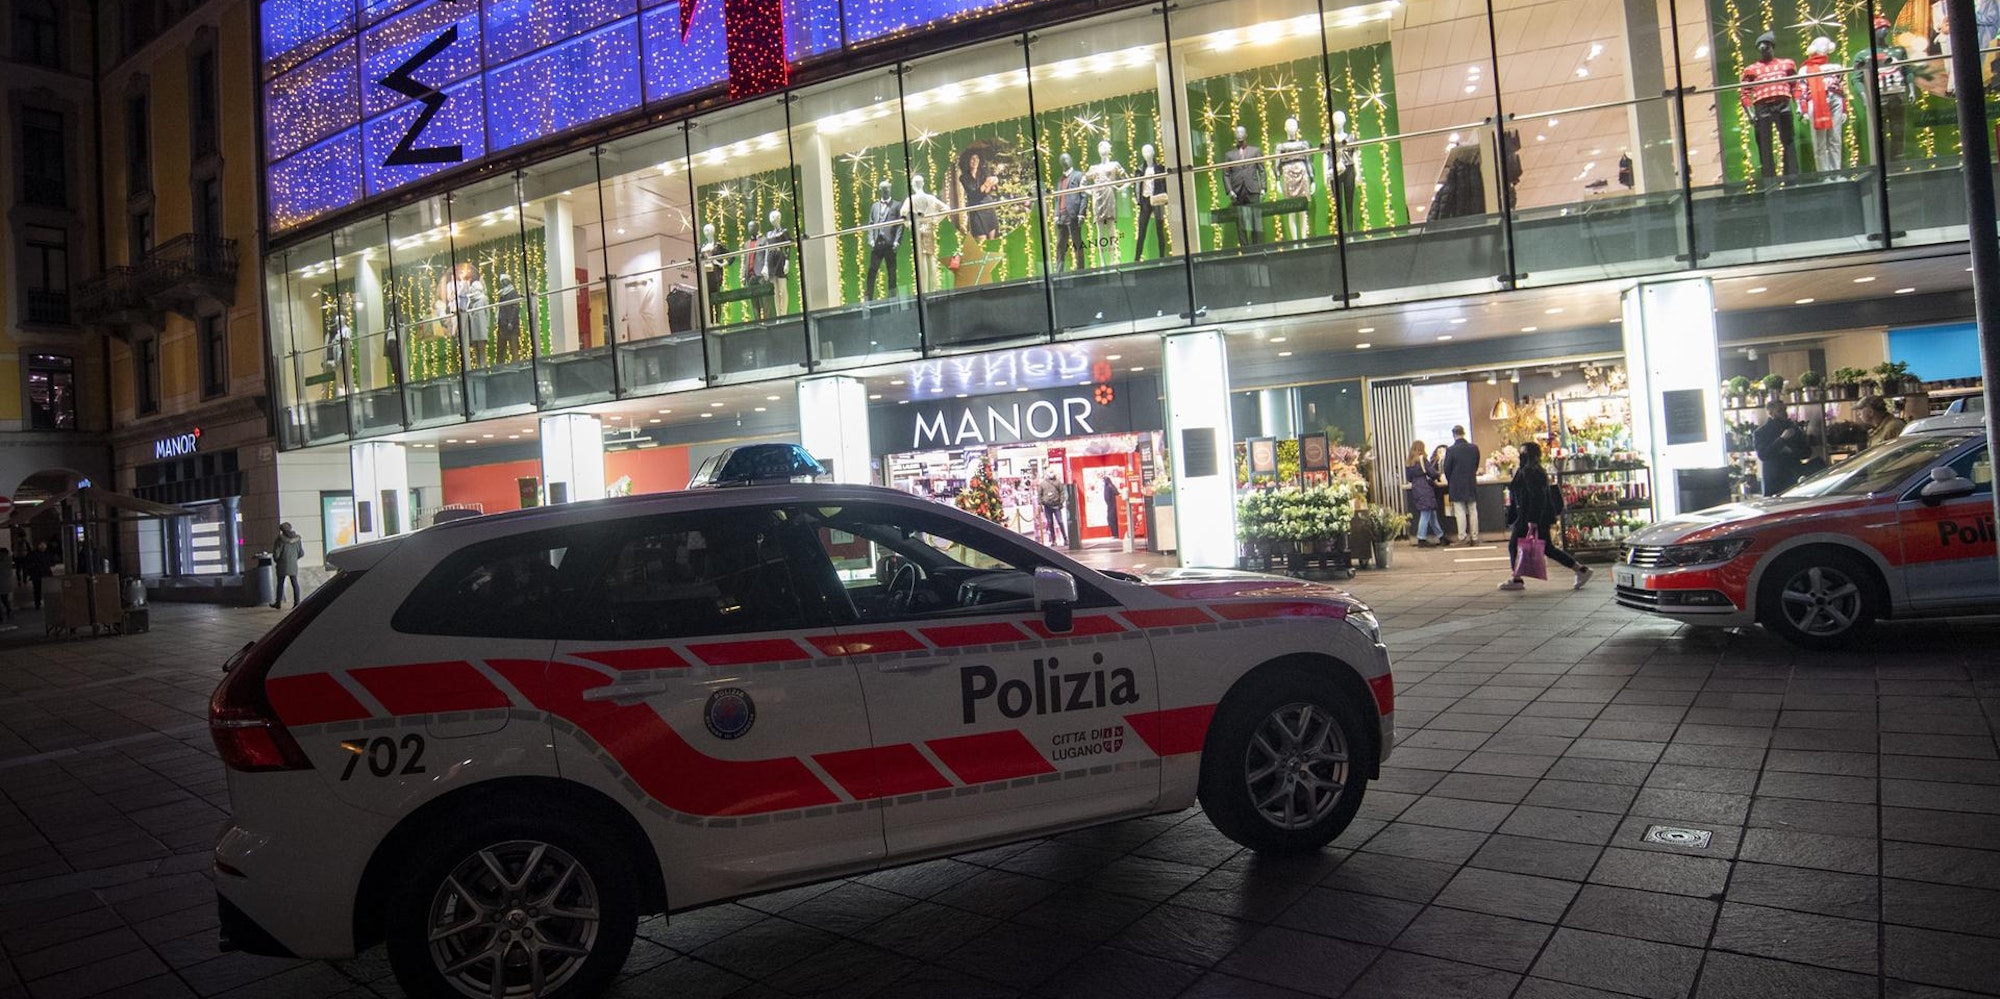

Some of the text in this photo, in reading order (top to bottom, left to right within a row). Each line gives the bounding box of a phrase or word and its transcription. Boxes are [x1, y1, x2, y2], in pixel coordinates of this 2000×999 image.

[913, 397, 1094, 448] MANOR
[156, 433, 196, 459] MANOR
[960, 652, 1140, 724] Polizia
[1052, 743, 1103, 761] LUGANO
[1091, 728, 1103, 741] DI
[340, 733, 426, 781] 702
